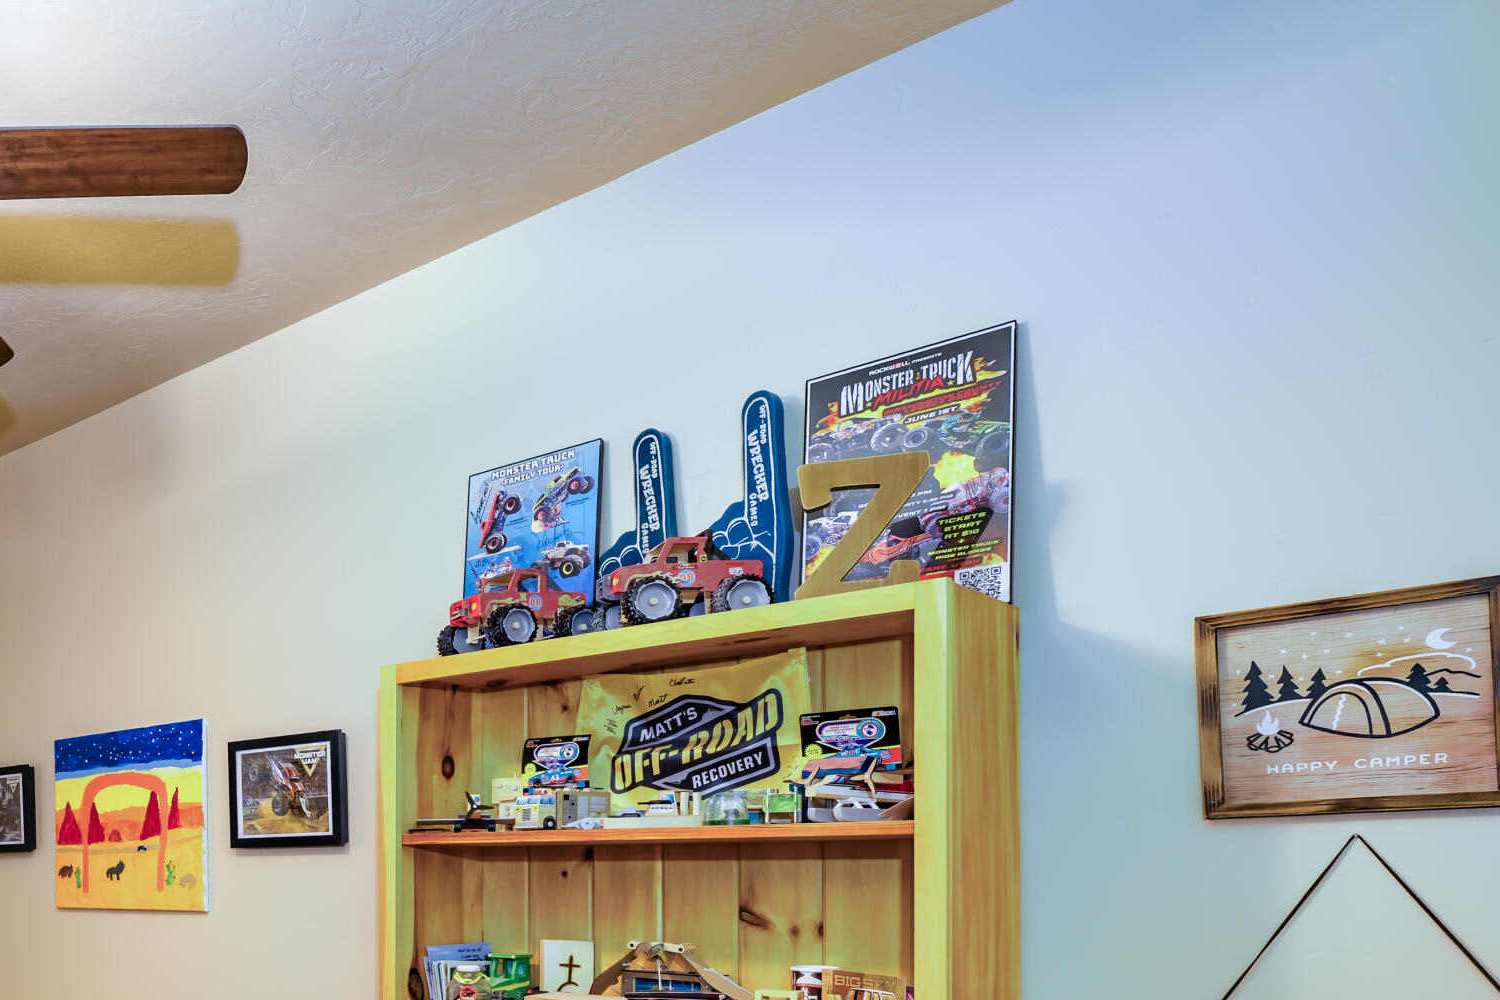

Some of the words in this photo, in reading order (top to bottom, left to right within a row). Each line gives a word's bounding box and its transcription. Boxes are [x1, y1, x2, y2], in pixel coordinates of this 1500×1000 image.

[840, 369, 914, 416] MONSTER
[920, 350, 975, 386] TRUCK
[868, 360, 910, 376] ROCKWELL
[873, 375, 945, 409] MILITIA
[904, 411, 937, 424] JUNE
[491, 459, 539, 481] MONSTER
[540, 449, 576, 466] TRUCK
[747, 429, 770, 503] WRECKER
[639, 463, 661, 532] WRECKER
[749, 492, 759, 527] GAMES
[938, 511, 988, 526] TICKETS
[944, 521, 983, 533] START
[927, 545, 970, 557] MONSTER
[944, 533, 960, 541] AT
[639, 706, 698, 742] MATT'S
[614, 692, 779, 791] OFF-ROAD
[691, 751, 764, 789] RECOVERY
[1266, 760, 1338, 775] HAPPY
[1354, 752, 1449, 769] CAMPER
[833, 974, 861, 988] BIG
[862, 977, 897, 993] SKY
